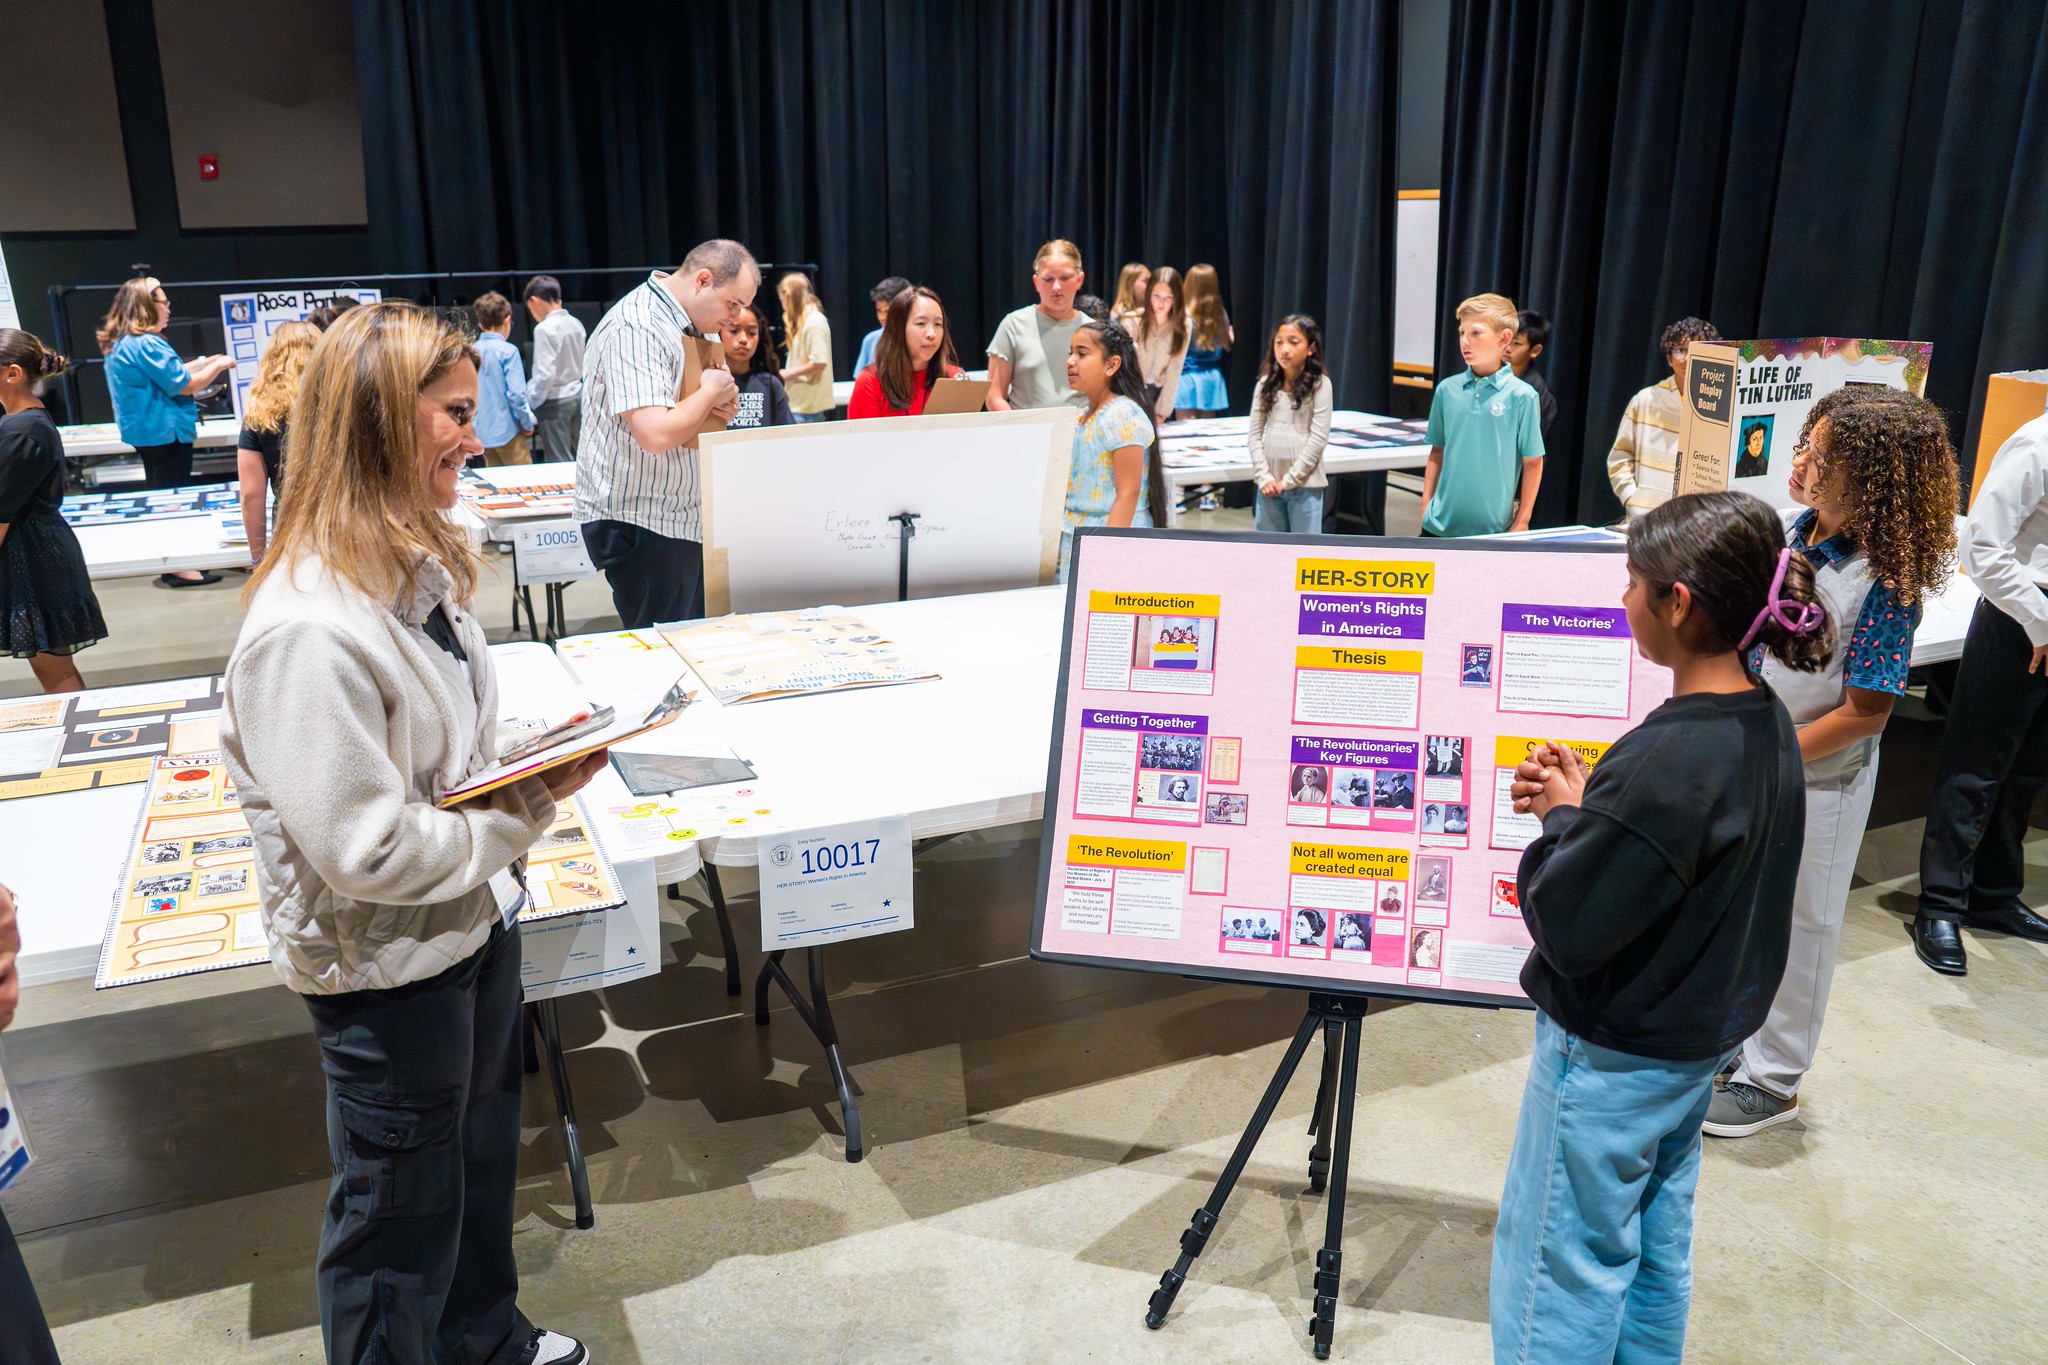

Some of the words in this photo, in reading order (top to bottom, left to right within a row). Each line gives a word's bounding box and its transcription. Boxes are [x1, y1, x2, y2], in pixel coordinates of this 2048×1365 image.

[257, 292, 297, 312] Rosa
[1702, 368, 1725, 383] Project
[1750, 367, 1778, 384] LIFE
[1786, 366, 1802, 383] OF
[1700, 383, 1722, 399] Display
[1767, 383, 1812, 402] LUTHER
[1698, 398, 1717, 412] Board
[1693, 450, 1709, 462] Great
[1711, 455, 1721, 466] For:
[1696, 463, 1710, 472] Science
[1695, 472, 1708, 480] School
[536, 531, 578, 546] 10005
[1300, 569, 1430, 588] HER-STORY
[1115, 595, 1194, 608] Introduction
[1303, 599, 1371, 613] Women’s
[1375, 602, 1424, 617] Rights
[1322, 621, 1335, 634] in
[1338, 622, 1402, 636] America
[1552, 616, 1615, 629] Victories’
[1332, 650, 1387, 665] Thesis
[786, 671, 873, 683] MOVEMENT
[1093, 712, 1138, 727] Getting
[1141, 715, 1196, 729] Together
[1322, 739, 1415, 753] Revolutionaries’
[1320, 751, 1342, 763] Key
[1345, 752, 1389, 765] Figures
[801, 838, 880, 874] 10017
[1105, 847, 1174, 861] Revolution’
[1293, 846, 1316, 857] Not
[1319, 848, 1334, 859] all
[1337, 851, 1384, 862] women
[1387, 854, 1408, 863] are
[1305, 863, 1355, 874] created
[1358, 866, 1394, 878] equal
[776, 880, 807, 889] HER-STORY:
